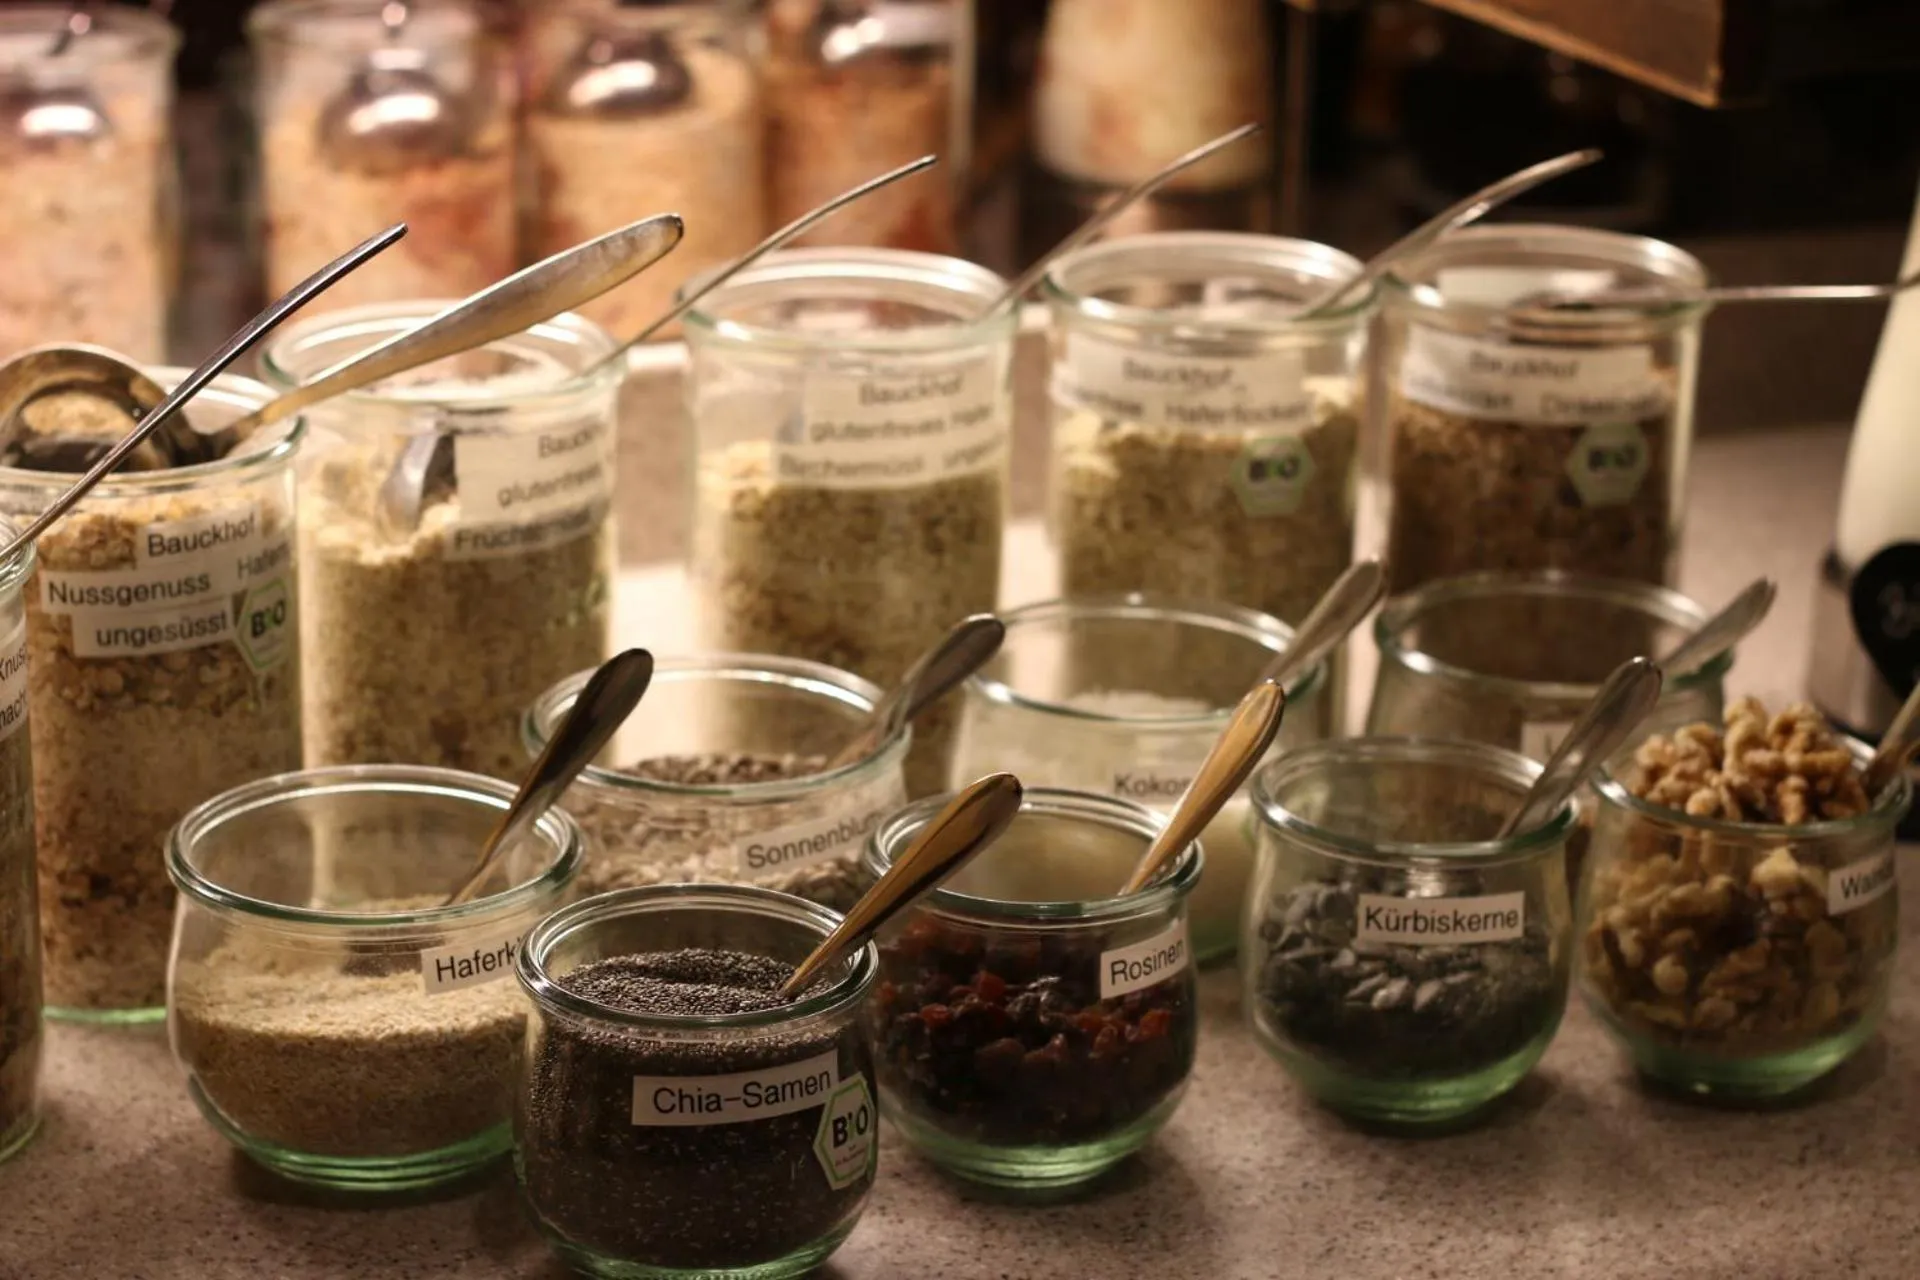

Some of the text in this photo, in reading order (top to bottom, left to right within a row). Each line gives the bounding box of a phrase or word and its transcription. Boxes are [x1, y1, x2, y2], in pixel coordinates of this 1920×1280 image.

[147, 513, 256, 559] Bauckhof
[48, 571, 212, 607] Nussgenuss
[95, 608, 228, 649] ungesüsst
[1364, 906, 1519, 936] Kürbiskerne
[435, 937, 519, 983] Haferk
[1110, 938, 1184, 987] Rosinen
[653, 1070, 831, 1115] Chia-Samen
